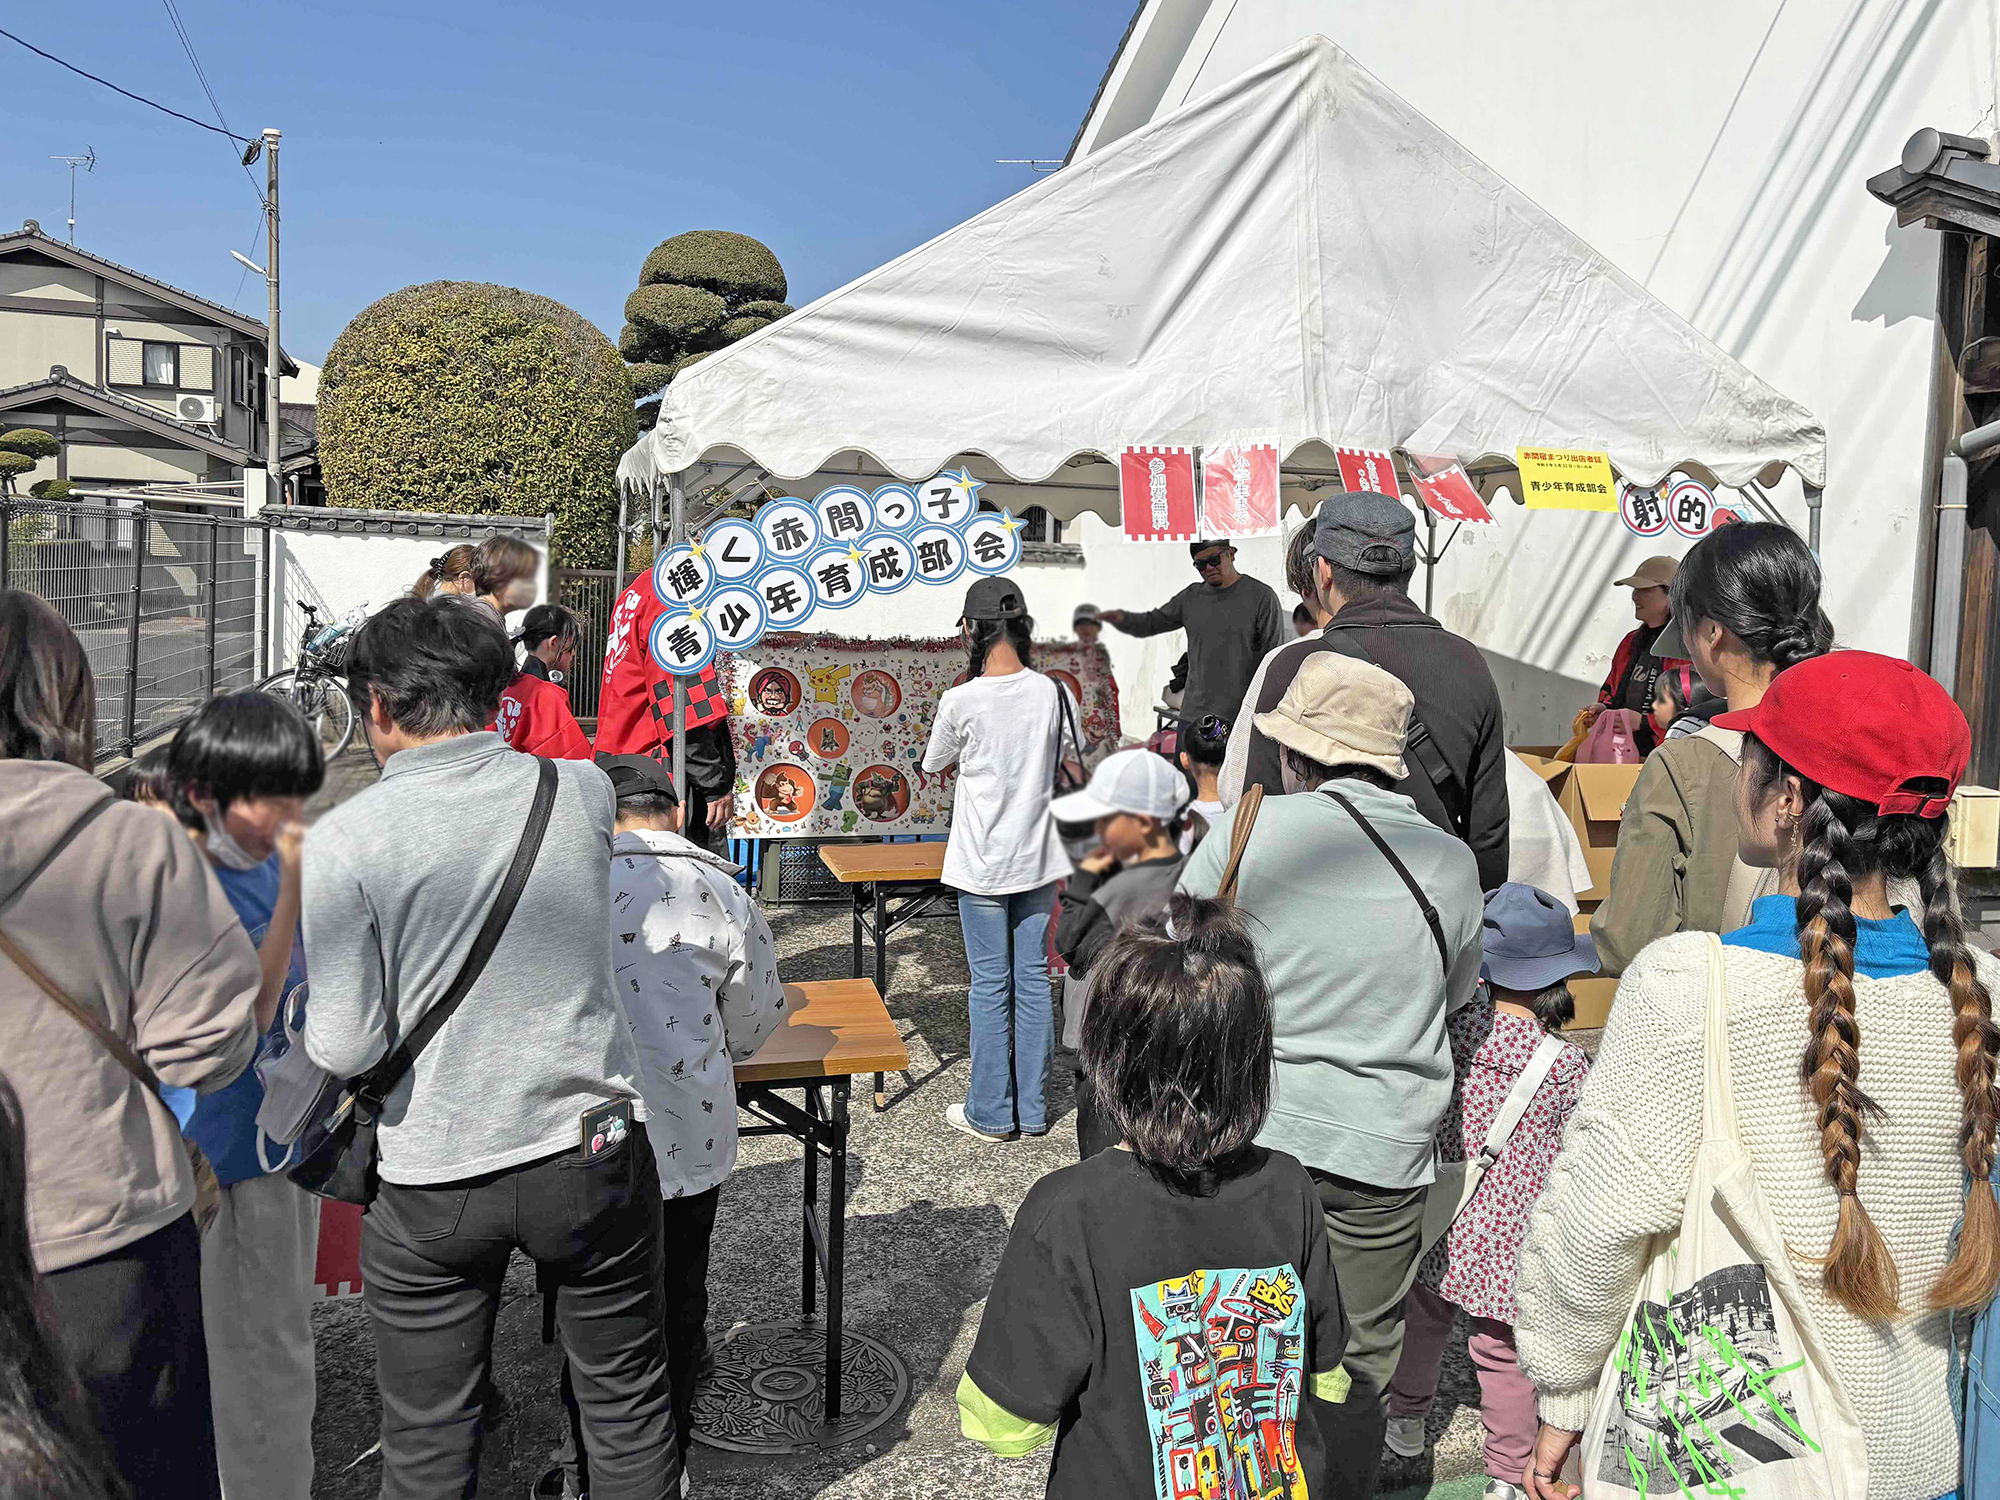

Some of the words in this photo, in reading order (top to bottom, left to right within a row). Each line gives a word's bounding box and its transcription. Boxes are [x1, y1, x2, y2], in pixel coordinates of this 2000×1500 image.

[1148, 457, 1169, 531] 参加費無料
[1232, 456, 1251, 525] 小学生まで
[1530, 480, 1608, 494] 青少年育成部会
[1631, 491, 1707, 531] 射的
[667, 486, 961, 600] 輝く赤間っ子
[666, 531, 1007, 665] 青少年育成部会
[1250, 1278, 1298, 1316] BDS
